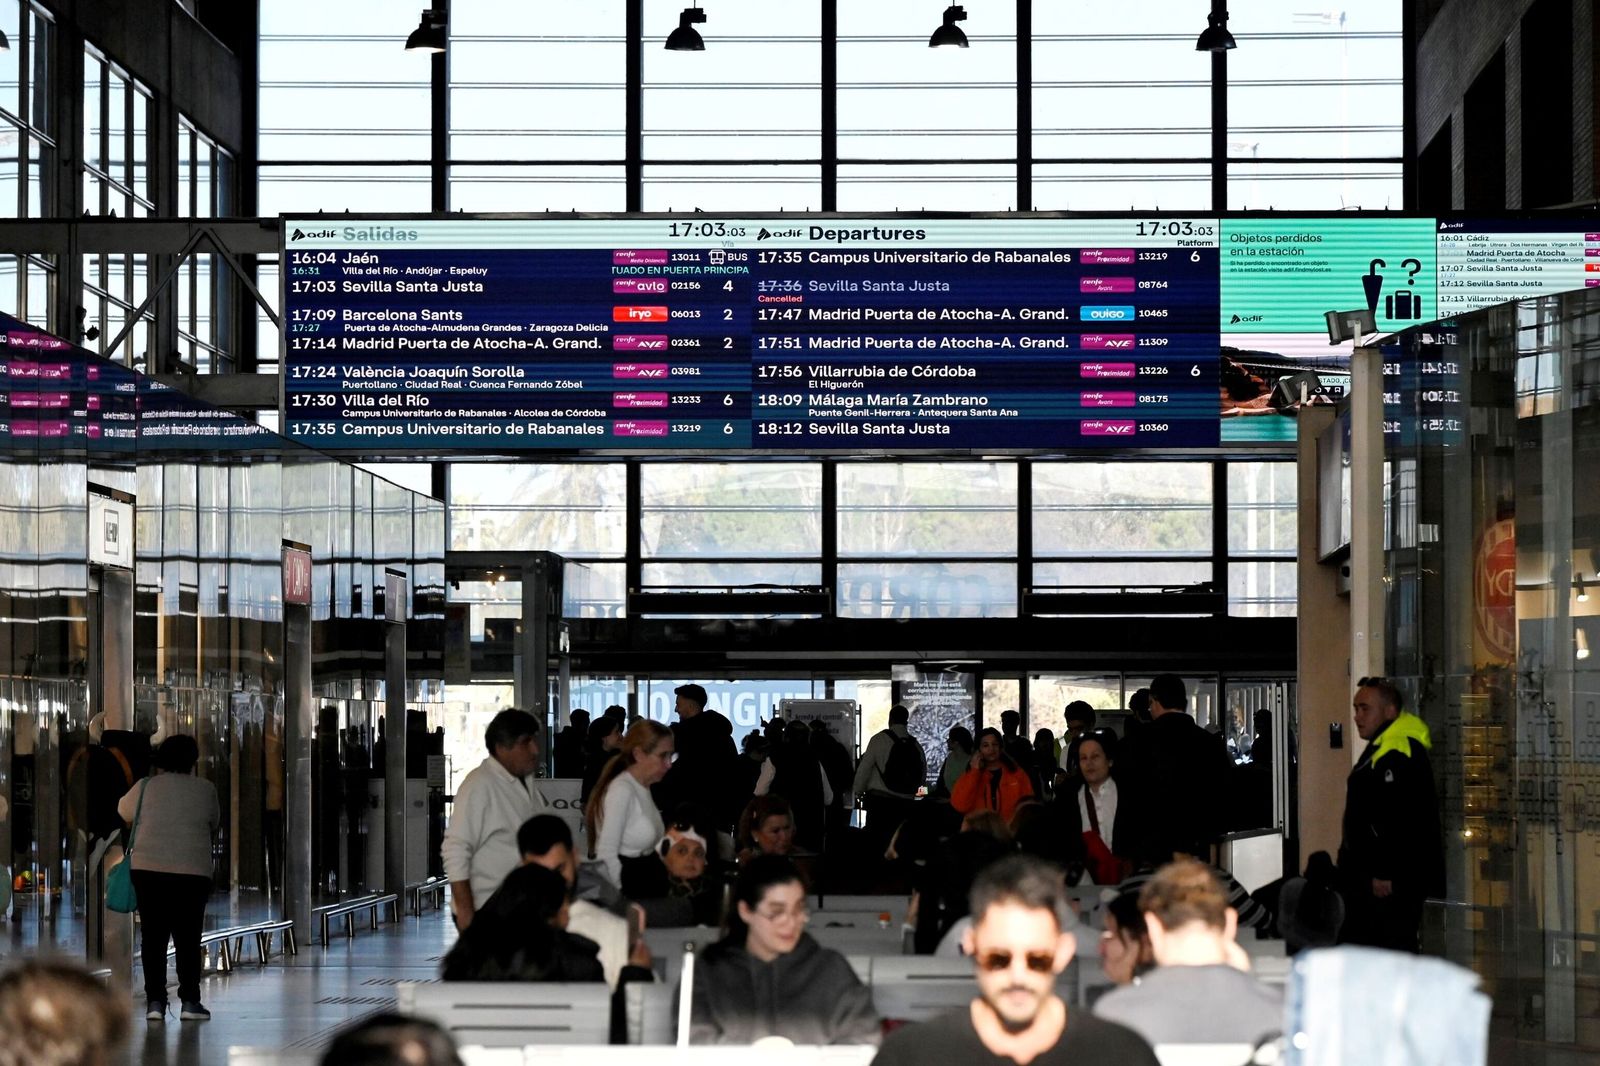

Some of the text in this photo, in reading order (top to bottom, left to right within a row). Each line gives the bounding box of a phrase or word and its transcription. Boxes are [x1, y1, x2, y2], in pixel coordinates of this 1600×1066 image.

[307, 230, 336, 238] adif
[343, 226, 418, 241] Salidas
[773, 229, 802, 237] adif
[809, 226, 926, 244] Departures
[1230, 233, 1322, 244] Objetos perdidos
[1246, 248, 1256, 256] la
[1259, 247, 1305, 256] estación
[292, 252, 748, 264] 16:04 Jaén 13011 BUS
[758, 251, 1200, 265] 17:35 Campus Universitario de Rabanales 13219 6
[612, 266, 749, 274] TUADO EN PUERTA PRINCIPA
[292, 281, 336, 292] 17:03
[343, 281, 392, 292] Sevilla
[396, 281, 438, 292] Santa
[442, 281, 483, 292] Justa
[637, 281, 665, 292] avlo
[723, 280, 733, 292] 4
[809, 280, 949, 291] Sevilla Santa Justa
[1138, 281, 1168, 289] 08764
[292, 307, 733, 321] 17:09 Barcelona Sants iryo 06013 2
[758, 309, 802, 320] 17:47
[809, 308, 860, 320] Madrid
[865, 308, 913, 320] Puerta
[917, 308, 936, 320] de
[940, 308, 1015, 320] Atocha-A.
[1019, 308, 1069, 320] Grand.
[293, 338, 336, 349] 17:14
[343, 337, 394, 349] Madrid
[398, 337, 447, 349] Puerta
[451, 337, 470, 349] de
[473, 337, 548, 349] Atocha-A.
[553, 337, 602, 349] Grand.
[637, 340, 665, 349] AVE
[723, 337, 733, 349] 2
[758, 336, 1168, 349] 17:51 Madrid Puerta de Atocha-A. Grand. AVE 11309
[292, 365, 701, 380] 17:24 València Joaquín Sorolla AVE 03981
[759, 366, 802, 377] 17:56
[808, 365, 885, 377] Villarrubia
[889, 365, 908, 377] de
[912, 365, 976, 377] Córdoba
[1191, 365, 1200, 376] 6
[342, 380, 583, 389] Puertollano Ciudad Real Cuenca Fernando Zóbel
[292, 395, 336, 406] 17:30
[342, 394, 375, 406] Villa
[379, 394, 402, 406] del
[406, 394, 429, 406] Río
[723, 394, 733, 406] 6
[759, 394, 1168, 408] 18:09 Málaga María Zambrano 08175
[342, 409, 606, 419] Campus Universitario de Rabanales Alcolea de Córdoba
[292, 423, 336, 435] 17:35
[342, 423, 403, 437] Campus
[407, 423, 501, 435] Universitario
[505, 423, 524, 434] de
[528, 423, 604, 434] Rabanales
[723, 423, 733, 434] 6
[759, 423, 802, 434] 18:12
[809, 423, 858, 434] Sevilla
[862, 423, 905, 434] Santa
[909, 423, 950, 434] Justa
[1105, 425, 1132, 434] AVE
